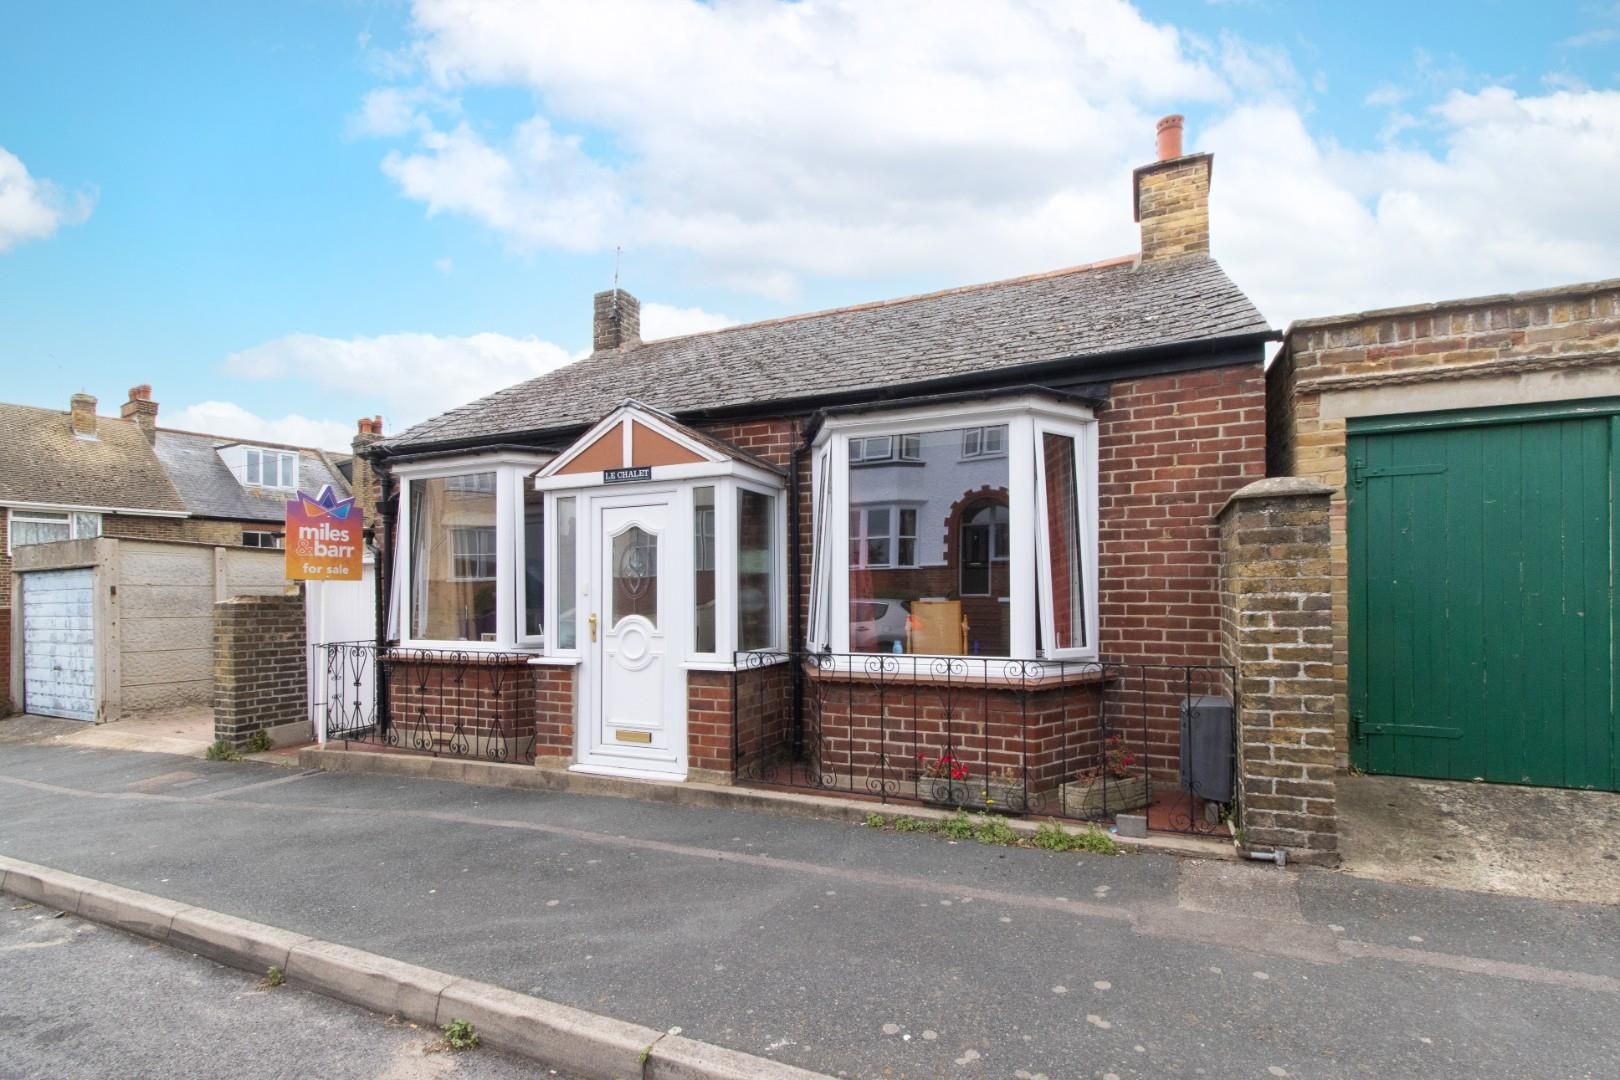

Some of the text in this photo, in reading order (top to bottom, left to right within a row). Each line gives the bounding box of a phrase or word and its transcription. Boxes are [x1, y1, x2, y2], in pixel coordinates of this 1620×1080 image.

[605, 469, 650, 480] LE CHALET
[298, 523, 350, 542] miles
[296, 539, 355, 558] & barr
[303, 562, 350, 575] for sale
